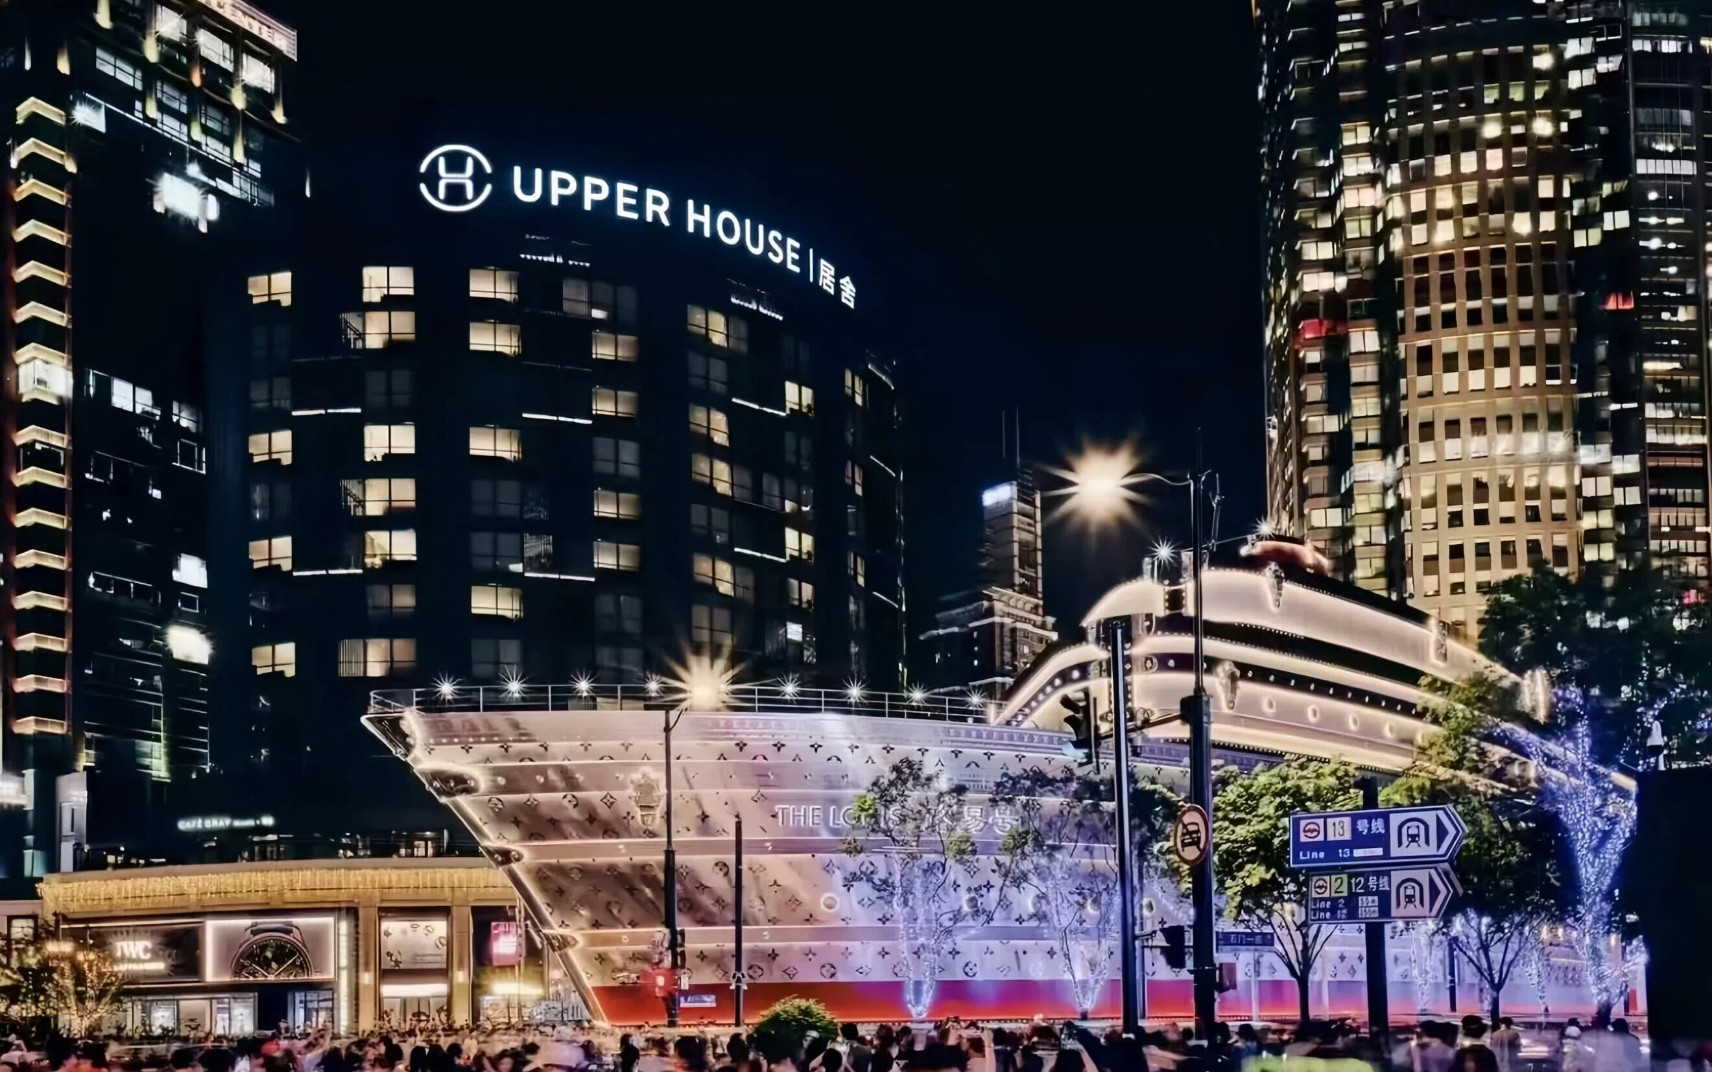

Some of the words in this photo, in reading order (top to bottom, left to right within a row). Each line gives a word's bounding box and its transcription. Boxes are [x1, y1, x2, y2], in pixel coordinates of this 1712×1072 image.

[513, 165, 671, 227] UPPER
[687, 199, 802, 274] HOUSE
[818, 257, 857, 310] 居舍
[775, 804, 821, 827] THE
[1332, 820, 1345, 838] 13
[1355, 817, 1385, 835] 号线
[1299, 850, 1325, 860] Line
[1338, 848, 1350, 858] 13
[1334, 876, 1344, 894] 2
[1311, 898, 1331, 909] Line
[1311, 909, 1331, 920] Line
[114, 940, 152, 960] IWC
